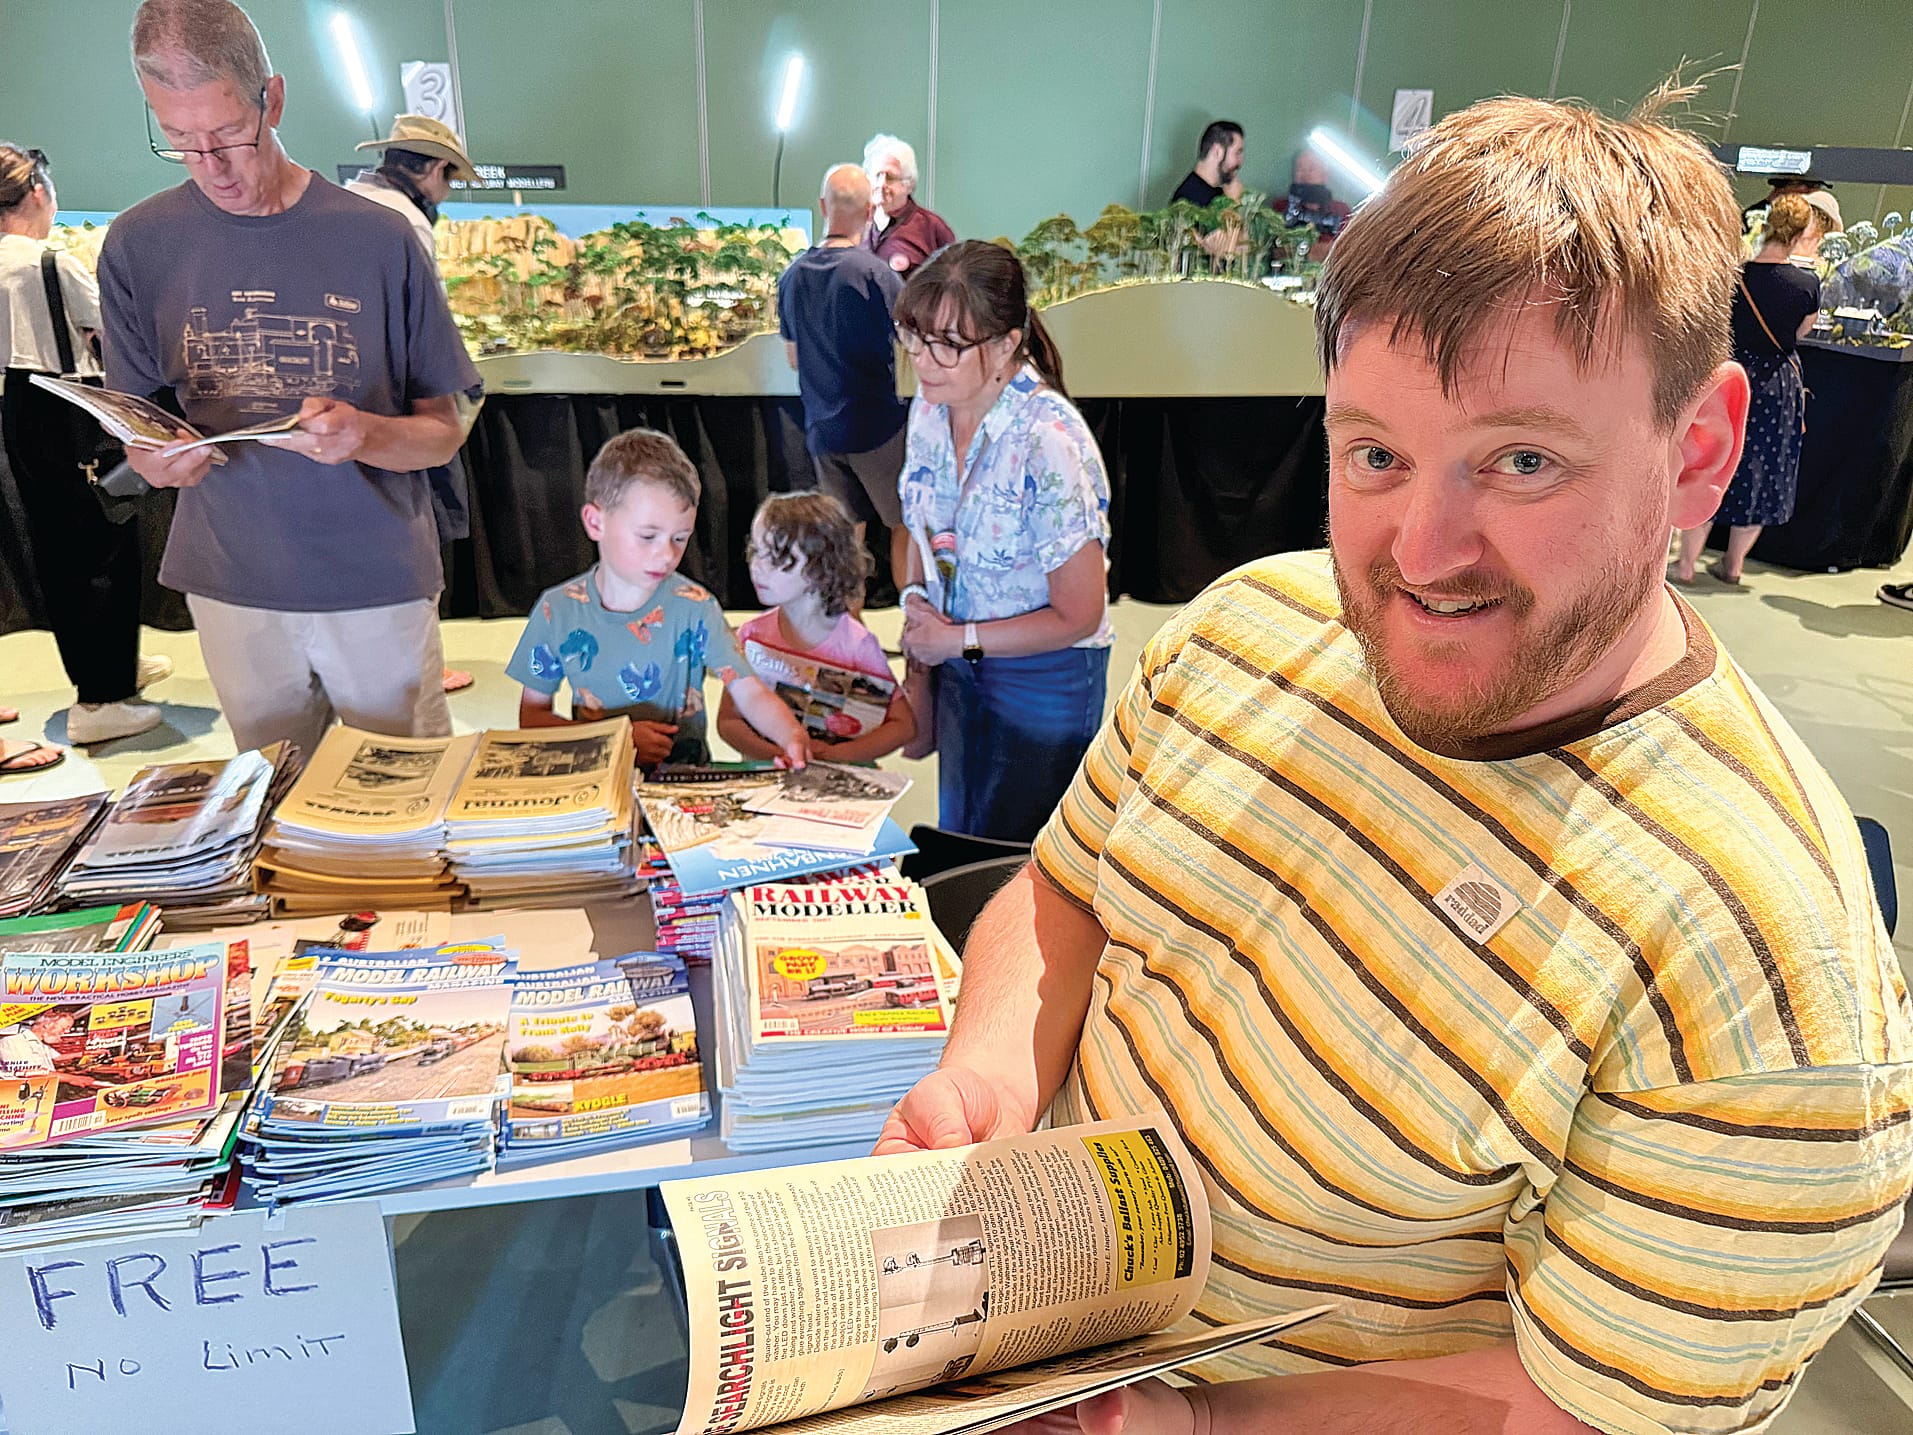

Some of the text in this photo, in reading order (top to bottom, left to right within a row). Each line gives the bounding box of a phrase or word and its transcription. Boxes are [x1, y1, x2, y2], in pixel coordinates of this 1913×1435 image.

[419, 69, 447, 119] 3
[753, 885, 913, 904] RAILWAY
[754, 901, 918, 917] MODELLER
[1443, 894, 1490, 935] raddad
[41, 956, 97, 967] MODEL
[4, 955, 219, 995] WORKSHOP
[330, 962, 507, 984] MODEL RAILWAY
[516, 974, 675, 1005] MODEL RAILWAY
[975, 1160, 984, 1168] the
[1082, 1159, 1094, 1181] Website
[982, 1176, 992, 1190] stock
[990, 1176, 999, 1185] not
[988, 1191, 999, 1211] ladder
[994, 1186, 1002, 1196] but
[1091, 1183, 1101, 1203] NMRA
[760, 1200, 769, 1214] inside
[1094, 1142, 1134, 1280] Chuck's Ballast Supplies
[693, 1190, 749, 1272] SIGNALS
[995, 1212, 1005, 1233] bridge
[767, 1224, 777, 1244] should
[763, 1243, 771, 1252] the
[1000, 1235, 1009, 1255] signal
[1008, 1239, 1017, 1259] signal
[755, 1251, 763, 1263] into
[25, 1236, 320, 1331] FREE
[758, 1266, 766, 1282] tube
[777, 1266, 785, 1283] little,
[780, 1292, 788, 1305] just
[708, 1279, 755, 1425] SEARCHLIGHT
